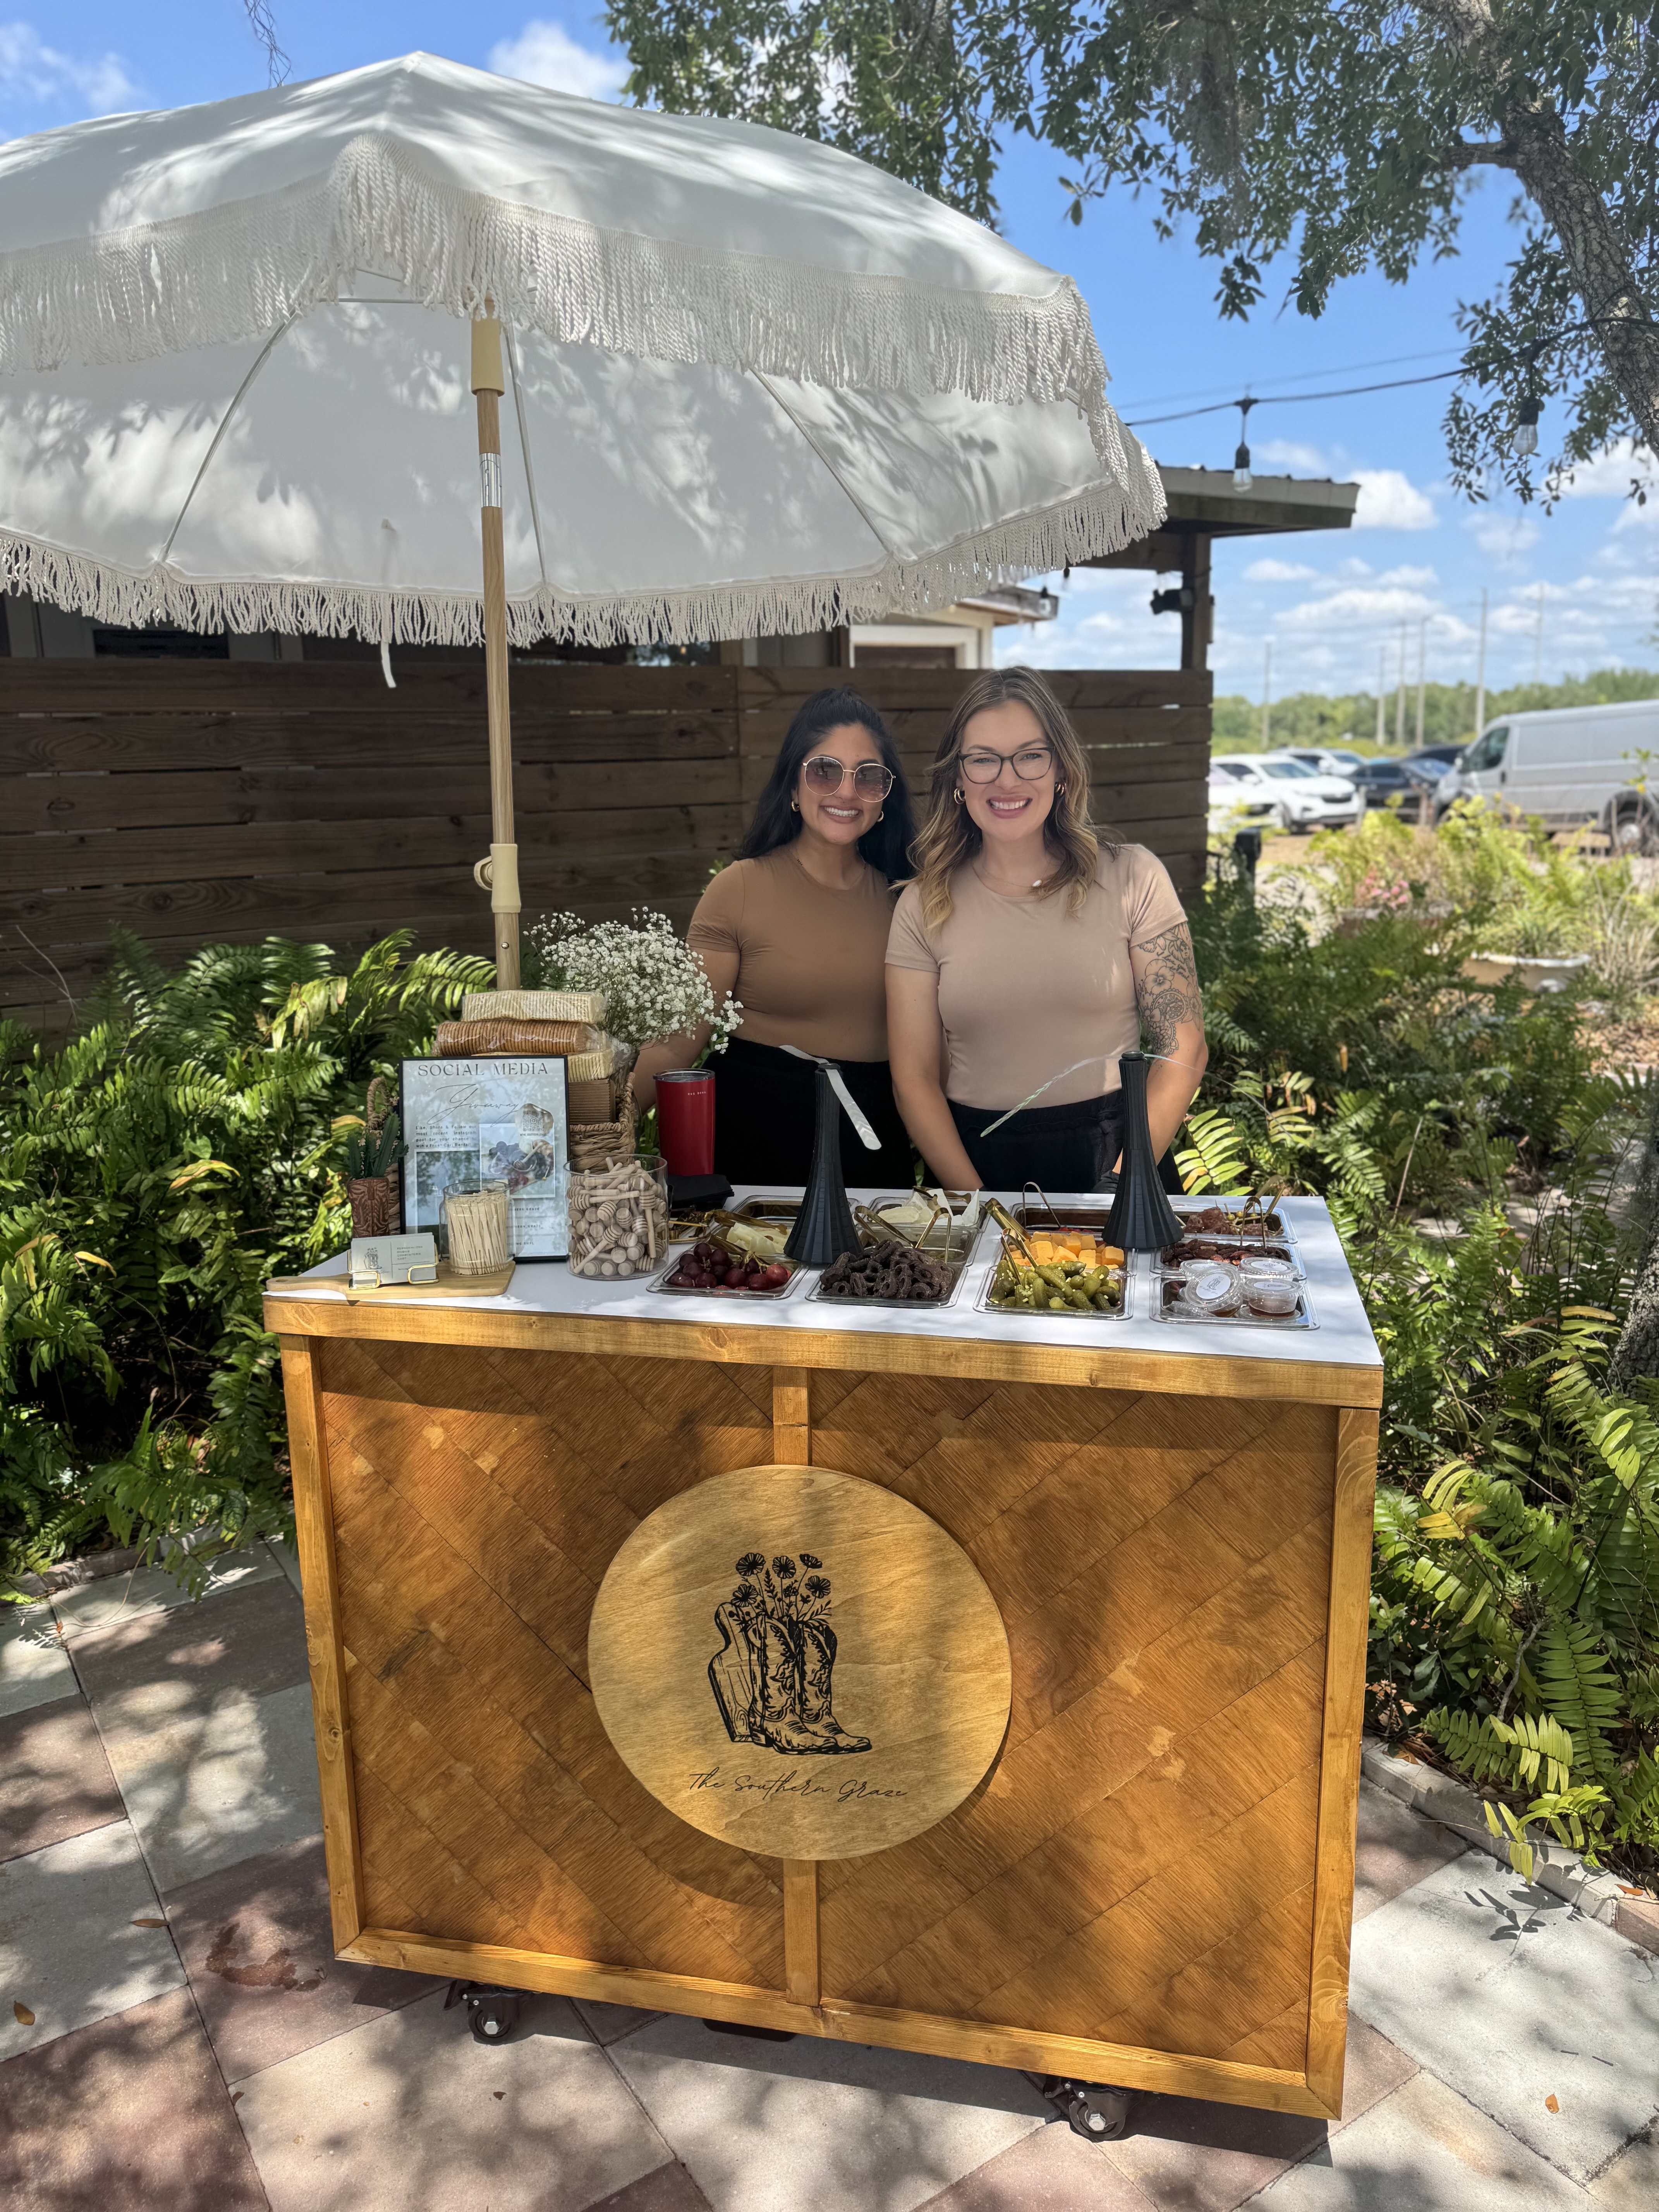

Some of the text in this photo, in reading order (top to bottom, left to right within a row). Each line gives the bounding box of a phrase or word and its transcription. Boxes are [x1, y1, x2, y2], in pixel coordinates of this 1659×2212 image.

[418, 1062, 548, 1076] SOCIAL MEDIA
[427, 1084, 519, 1127] Giveaway
[689, 1766, 908, 1802] The Southern Graze
